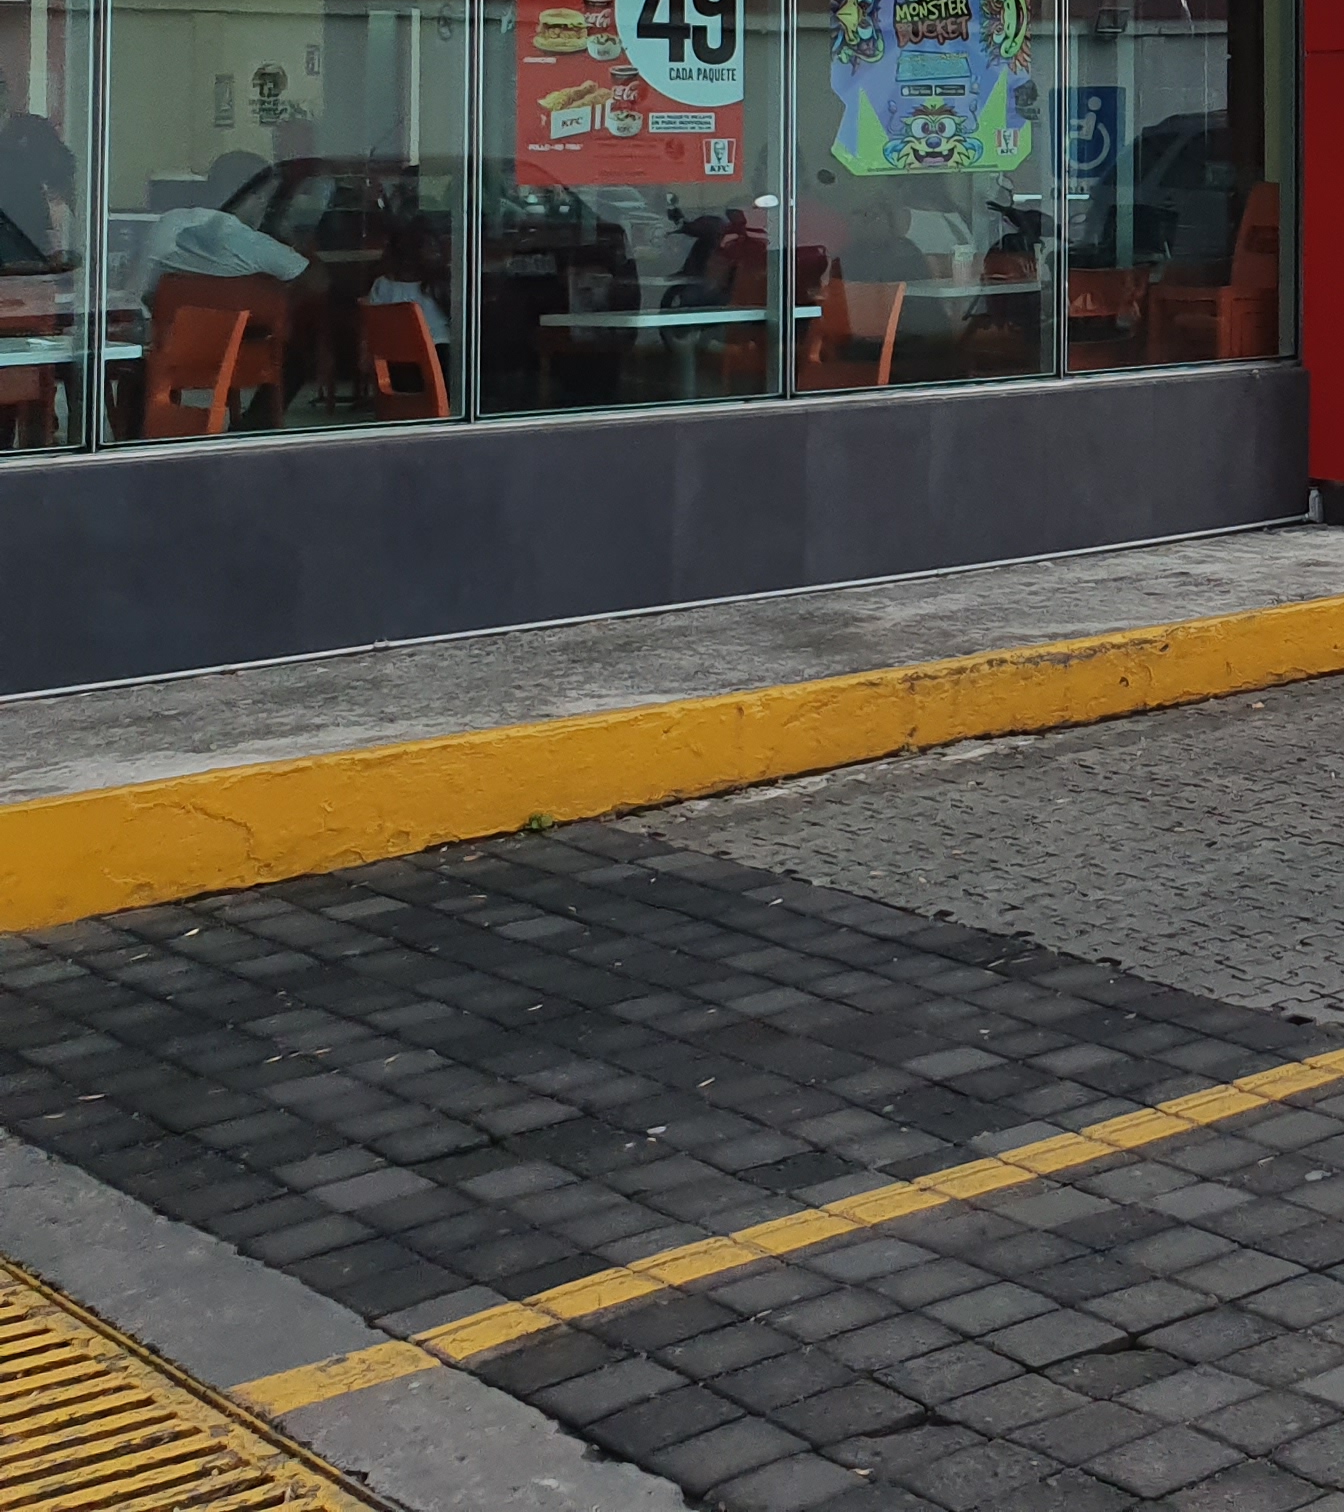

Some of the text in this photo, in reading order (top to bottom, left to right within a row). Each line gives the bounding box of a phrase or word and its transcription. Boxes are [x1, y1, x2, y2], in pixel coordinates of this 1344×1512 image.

[895, 18, 970, 46] BUCKET
[669, 68, 737, 81] CADA PAQUETE
[709, 164, 729, 173] KFC
